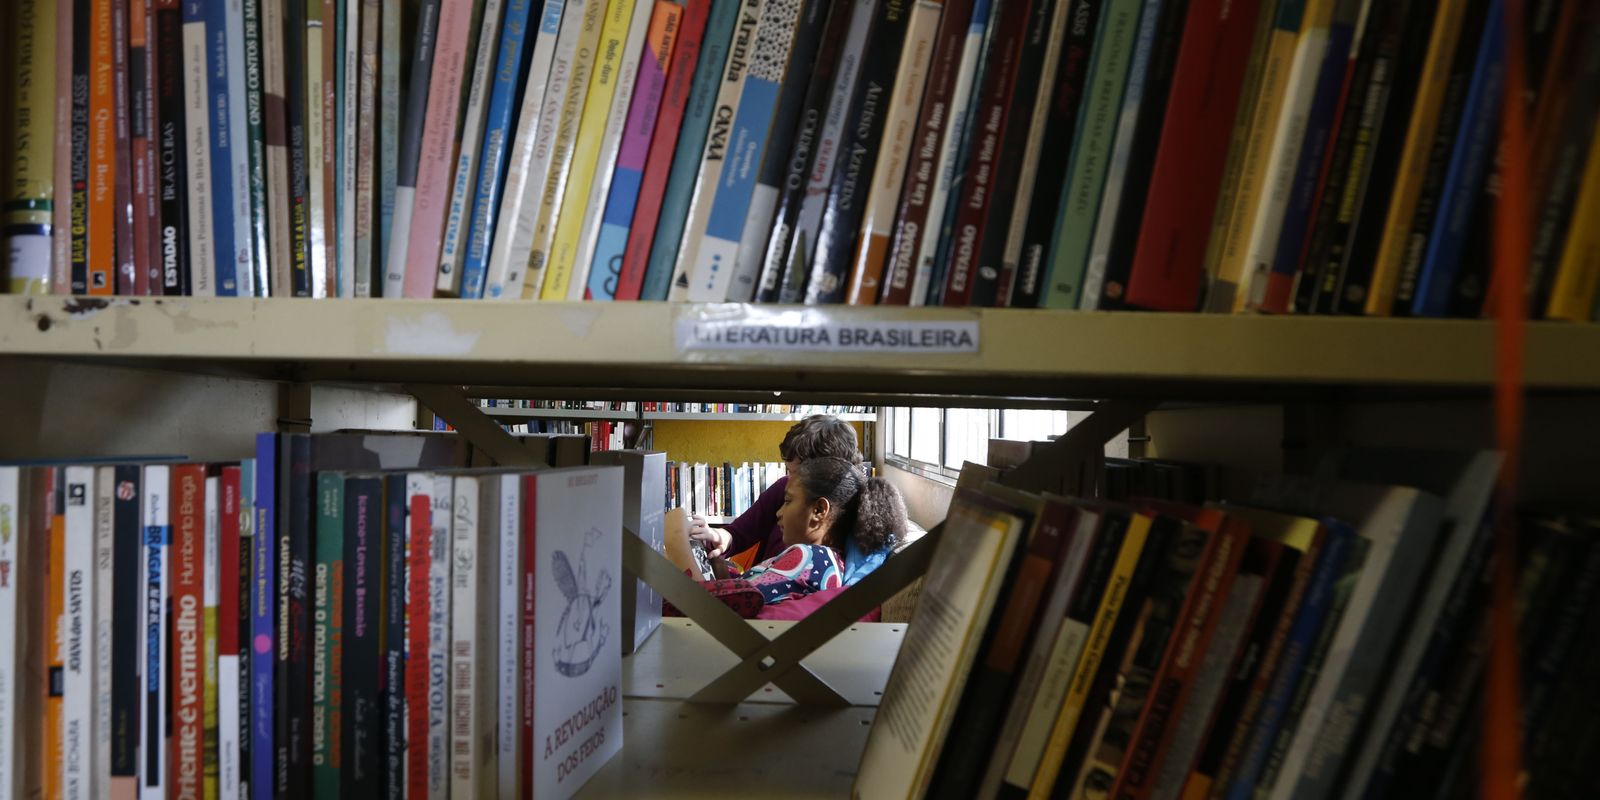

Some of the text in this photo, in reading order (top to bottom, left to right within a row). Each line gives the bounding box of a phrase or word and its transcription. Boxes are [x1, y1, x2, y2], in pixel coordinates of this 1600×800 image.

[98, 41, 109, 56] DE
[246, 22, 258, 37] DE
[663, 13, 677, 33] JOÃO
[727, 12, 760, 83] Aranha
[97, 62, 110, 96] ASSIS
[246, 40, 260, 89] CONTOS
[551, 57, 569, 94] JOÃO
[579, 47, 591, 59] O
[599, 39, 621, 86] Dedo-duro
[193, 77, 202, 109] Machado
[248, 92, 260, 126] ONZE
[558, 62, 588, 144] AMANUENSE
[74, 74, 88, 181] MACHADO DE ASSIS
[162, 122, 176, 166] CUBAS
[324, 81, 334, 163] Machado de Assis
[840, 82, 884, 211] ALUÍSIO AZEVEDO
[96, 108, 110, 202] Quincas Borba
[542, 145, 568, 207] BELMIRO
[788, 175, 802, 191] O
[72, 192, 86, 235] GARCIA
[195, 127, 208, 291] Memórias Póstumas de Brás Cubas
[469, 128, 502, 260] LITERATURA COMENTADA
[892, 102, 945, 289] ESTADÃO Lira dos Vinte Anos
[951, 105, 1003, 292] ESTADÃO Lira dos Vinte Anos
[163, 226, 177, 288] ESTADÃO
[693, 327, 973, 348] LITERATURA BRASILEIRA
[180, 475, 197, 585] Humberto Braga
[356, 495, 368, 538] IGNÁCIO
[147, 525, 161, 582] BRAGA
[356, 546, 367, 586] LOYOLA
[390, 532, 399, 624] Melhores Contos
[506, 540, 514, 586] MARCELO
[69, 570, 82, 674] JOANA dos SANTOS
[279, 535, 290, 661] CADEIRAS PROIBIDAS
[354, 587, 368, 637] BRANDÃO
[176, 594, 197, 704] vermelho
[314, 563, 327, 765] O VERDE VIOLENTOU O MURO
[387, 650, 399, 694] Ignácio
[388, 697, 399, 711] de
[430, 652, 445, 727] LOYOLA
[502, 614, 515, 753] florestas imaginárias
[176, 708, 196, 724] é
[387, 713, 399, 751] Loyola
[544, 685, 617, 761] A REVOLUÇÃO
[557, 726, 606, 784] DOS FEIOS
